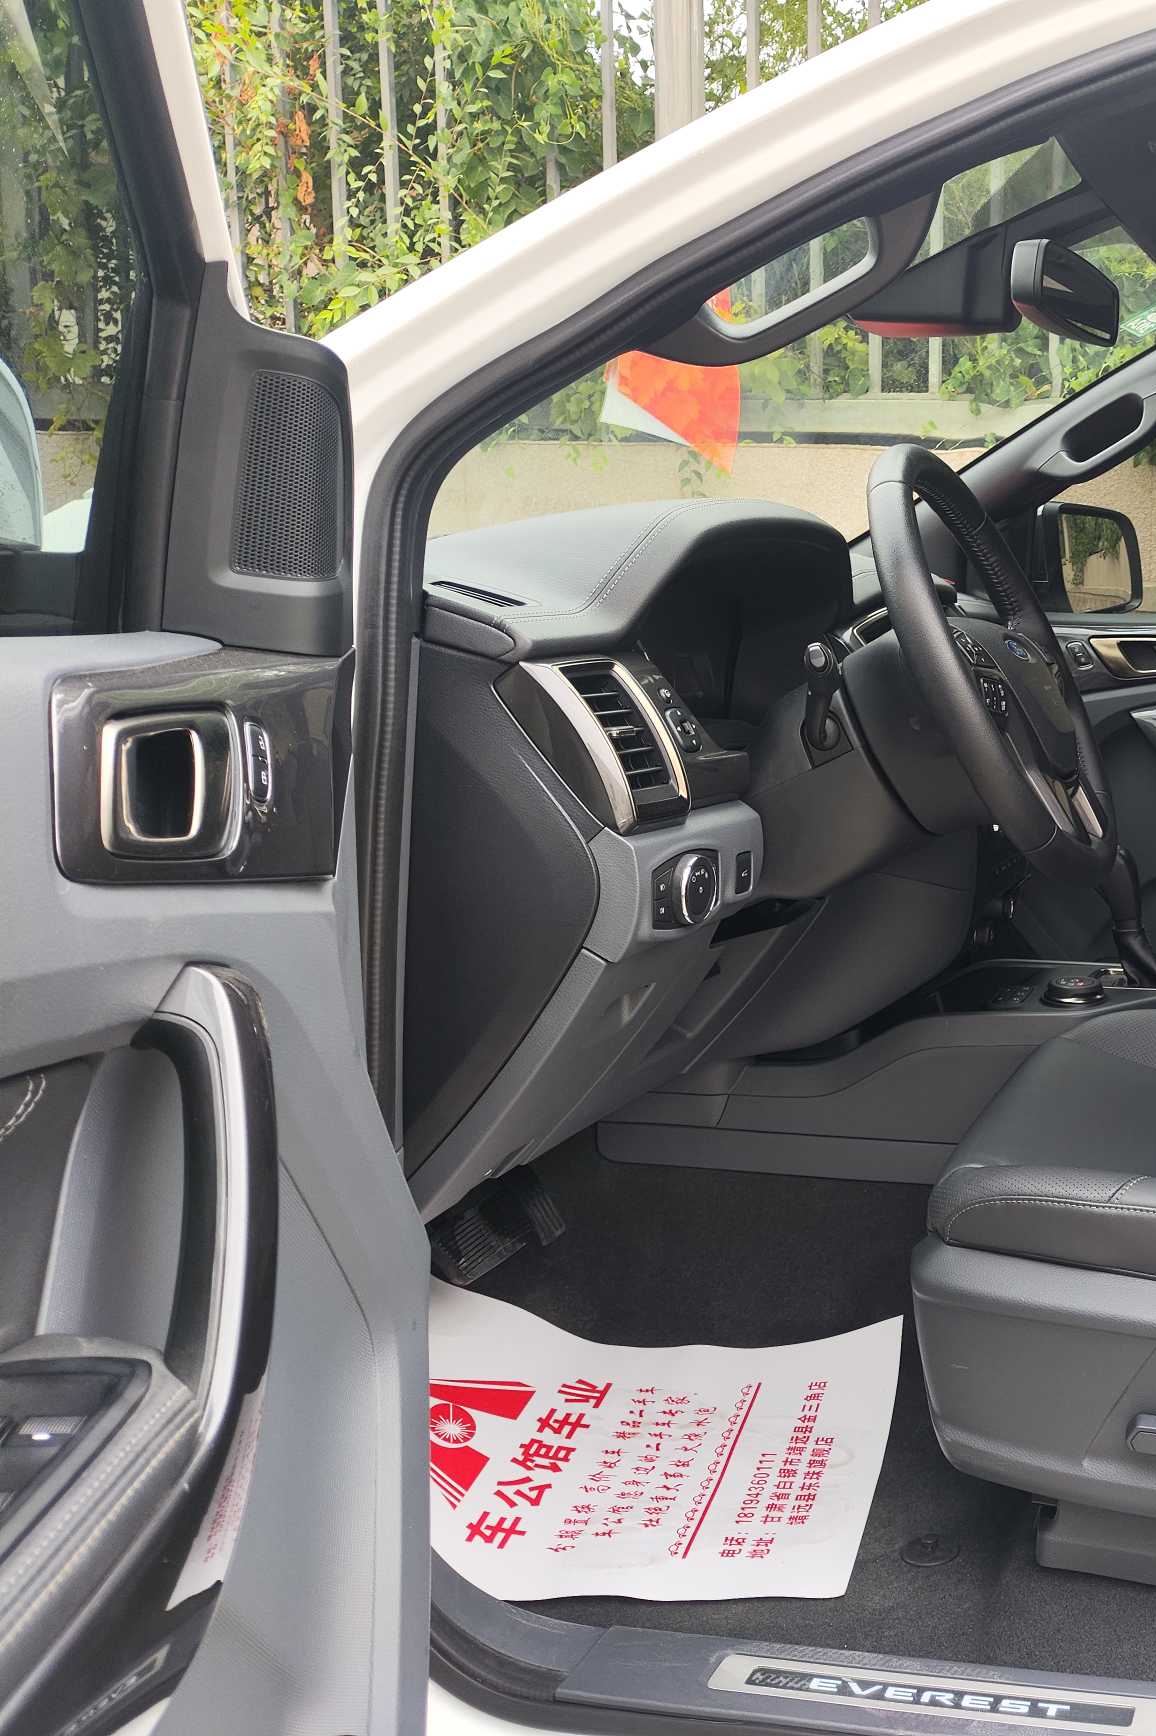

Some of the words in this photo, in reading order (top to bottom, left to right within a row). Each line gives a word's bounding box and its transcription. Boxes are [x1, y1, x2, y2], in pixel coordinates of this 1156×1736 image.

[466, 1378, 613, 1550] 车公馆车业
[808, 1676, 1072, 1718] EVEREST
